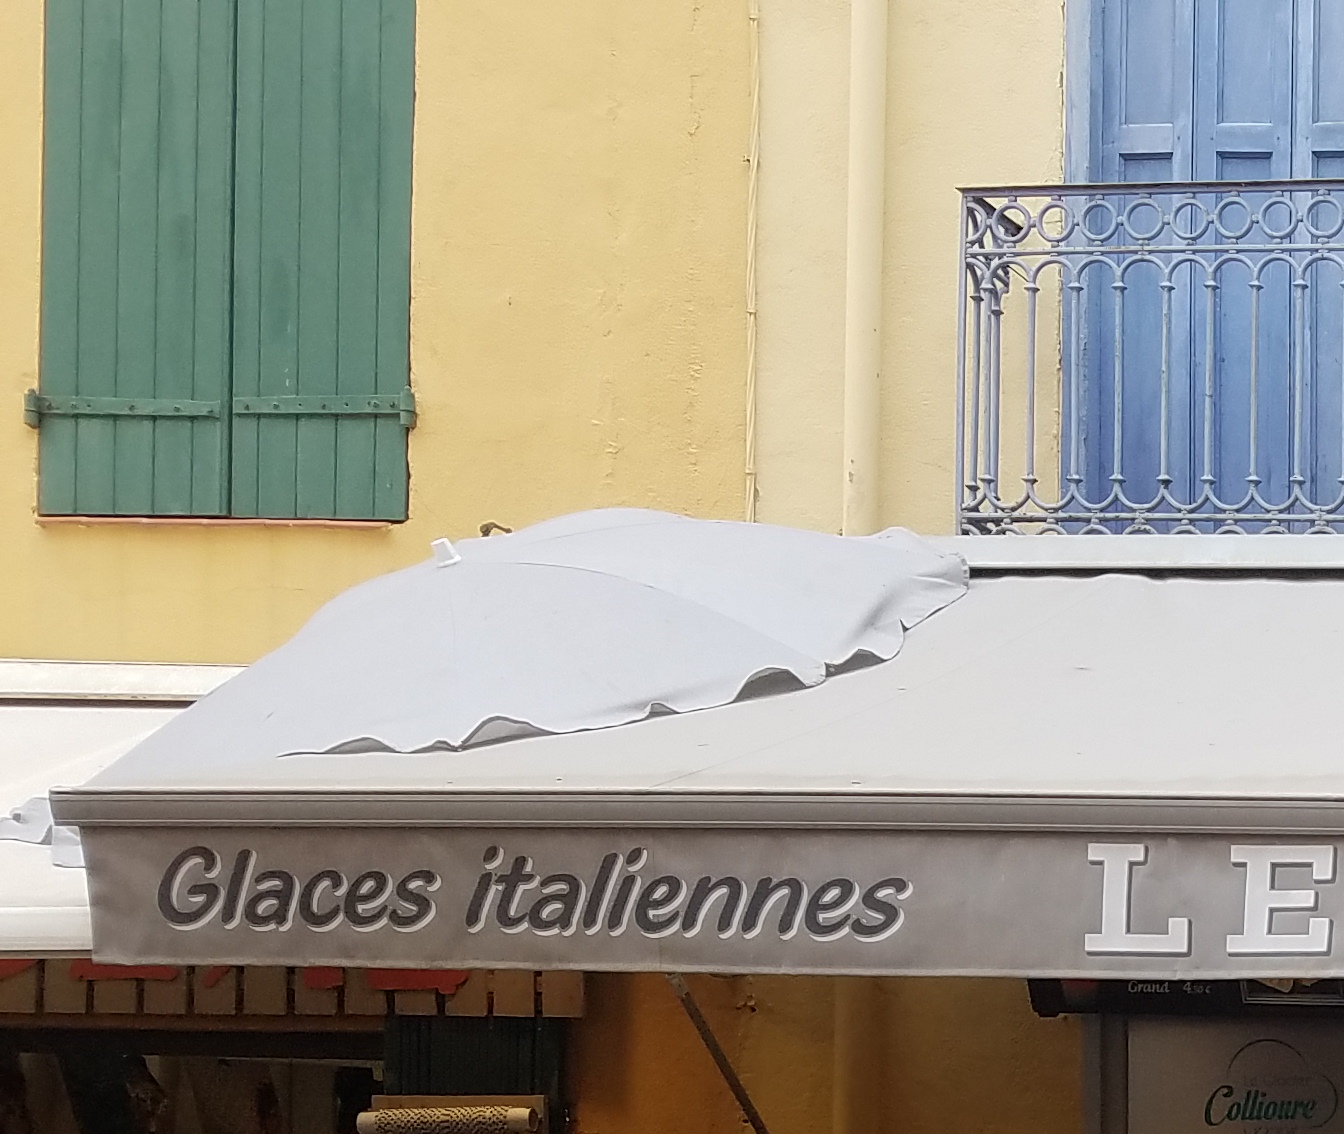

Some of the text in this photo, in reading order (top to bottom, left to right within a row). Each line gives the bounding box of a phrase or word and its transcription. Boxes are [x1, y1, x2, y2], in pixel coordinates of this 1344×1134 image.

[157, 844, 914, 942] Glaces italiennes
[1084, 841, 1338, 958] LE
[1127, 980, 1171, 993] Grand
[1204, 1085, 1318, 1127] Collioure
